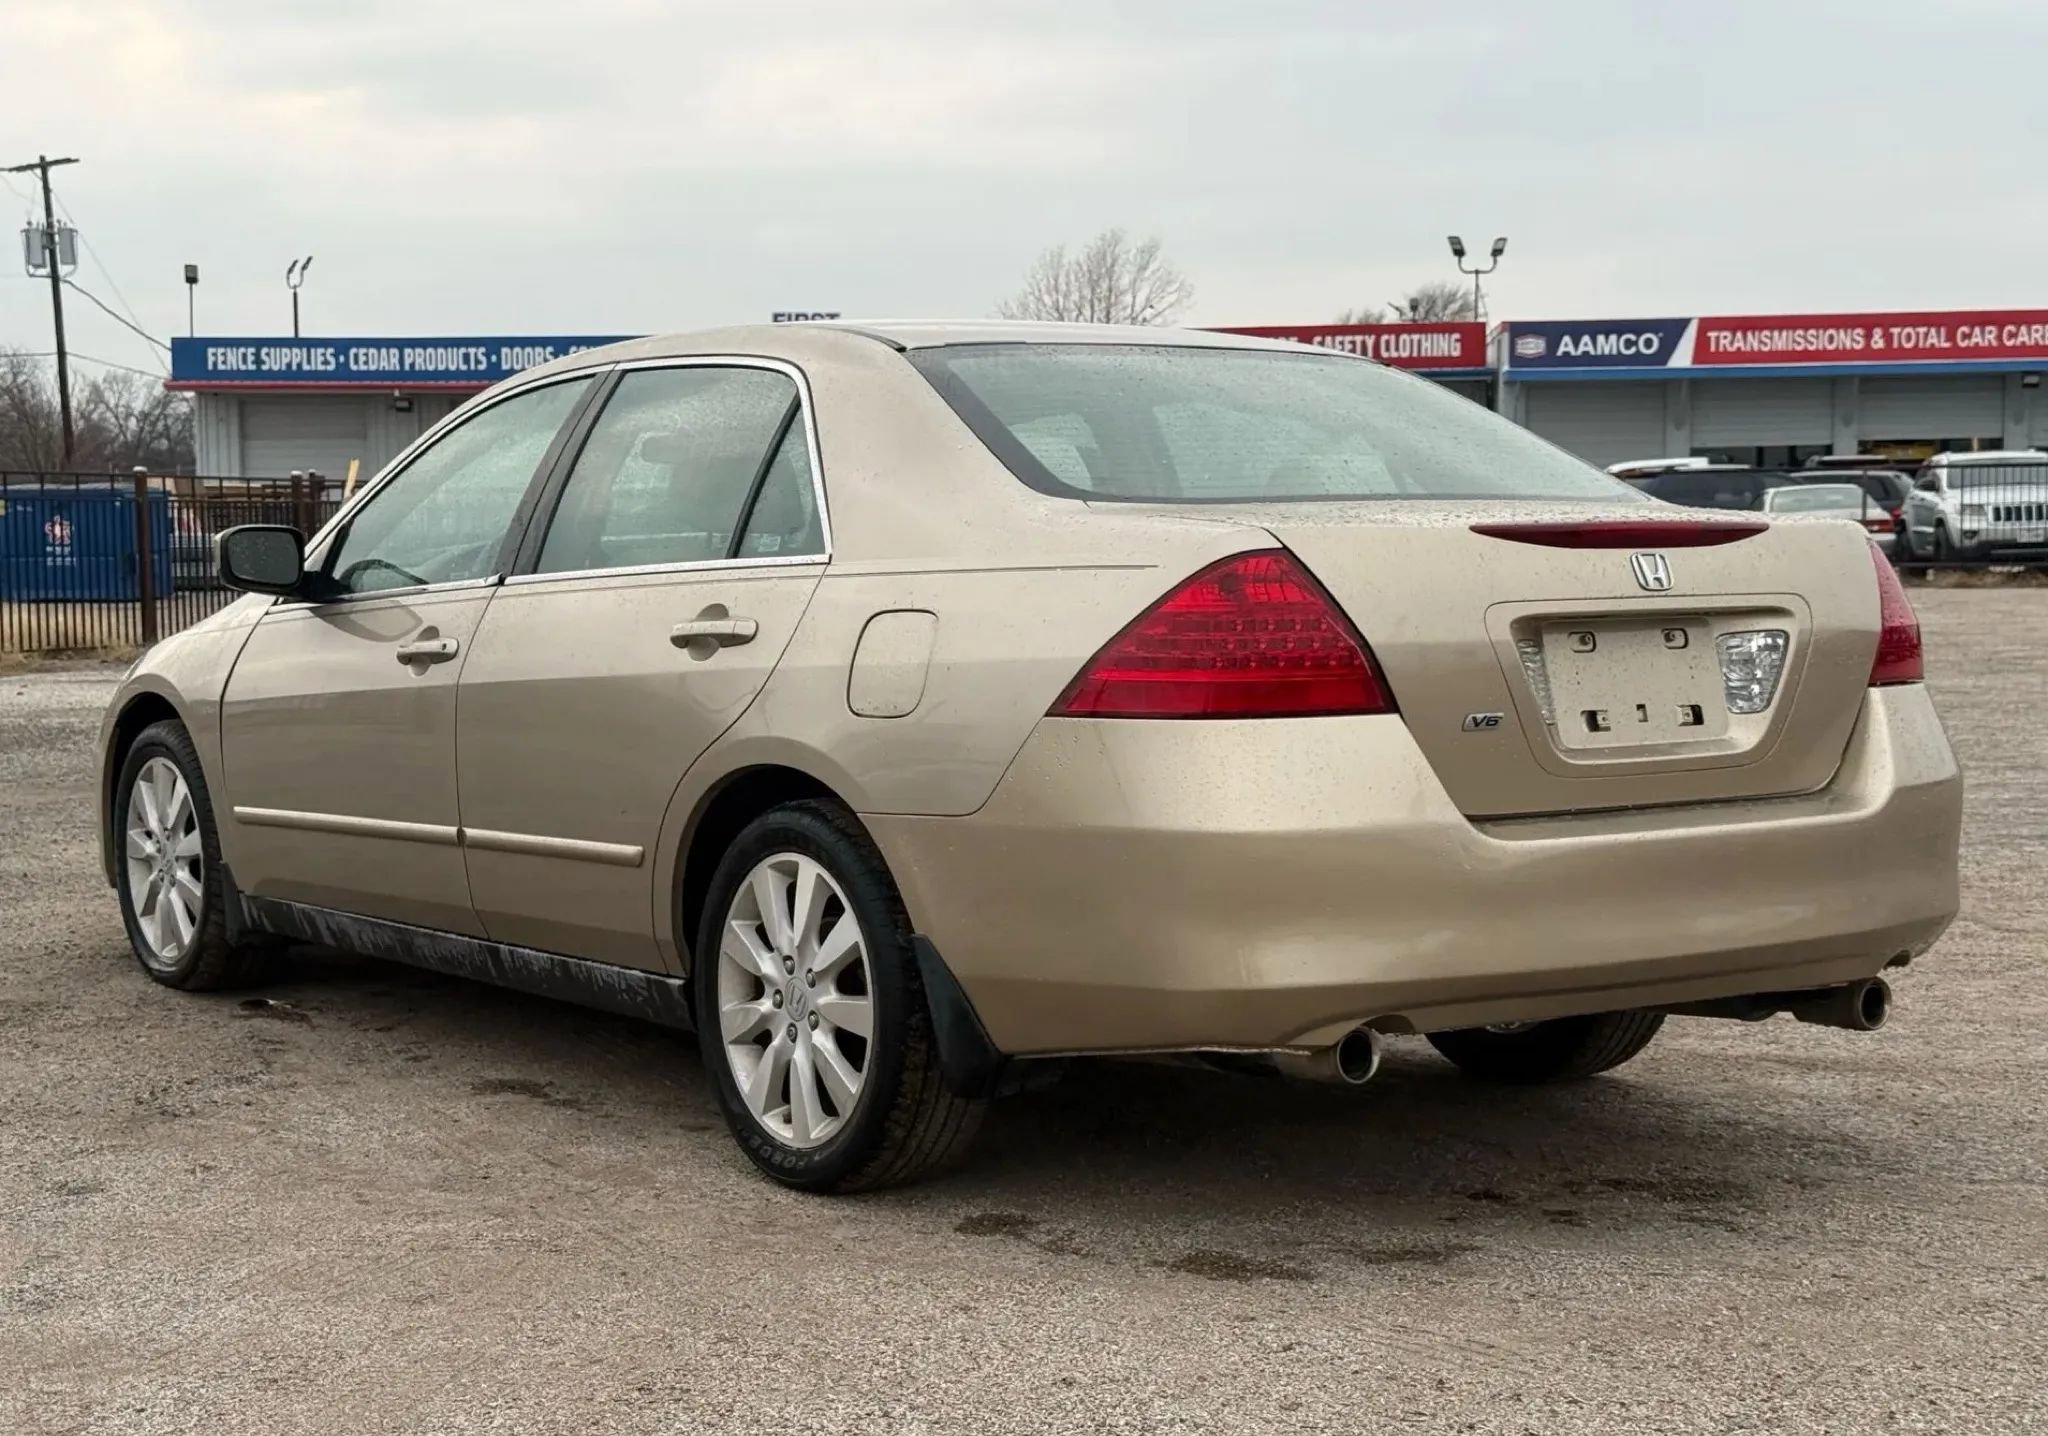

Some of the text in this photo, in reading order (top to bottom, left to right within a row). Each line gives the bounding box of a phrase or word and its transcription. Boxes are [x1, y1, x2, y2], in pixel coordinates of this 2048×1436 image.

[1380, 332, 1462, 358] CLOTHING
[1555, 332, 1661, 356] AAMCO
[1707, 323, 2048, 352] TRANSMISSIONS & TOTAL CAR CAR
[206, 346, 257, 371] FENCE
[260, 347, 336, 371] SUPPLIES
[349, 346, 400, 371] CEDAR
[403, 346, 487, 371] PRODUCTS
[1471, 714, 1504, 728] V6
